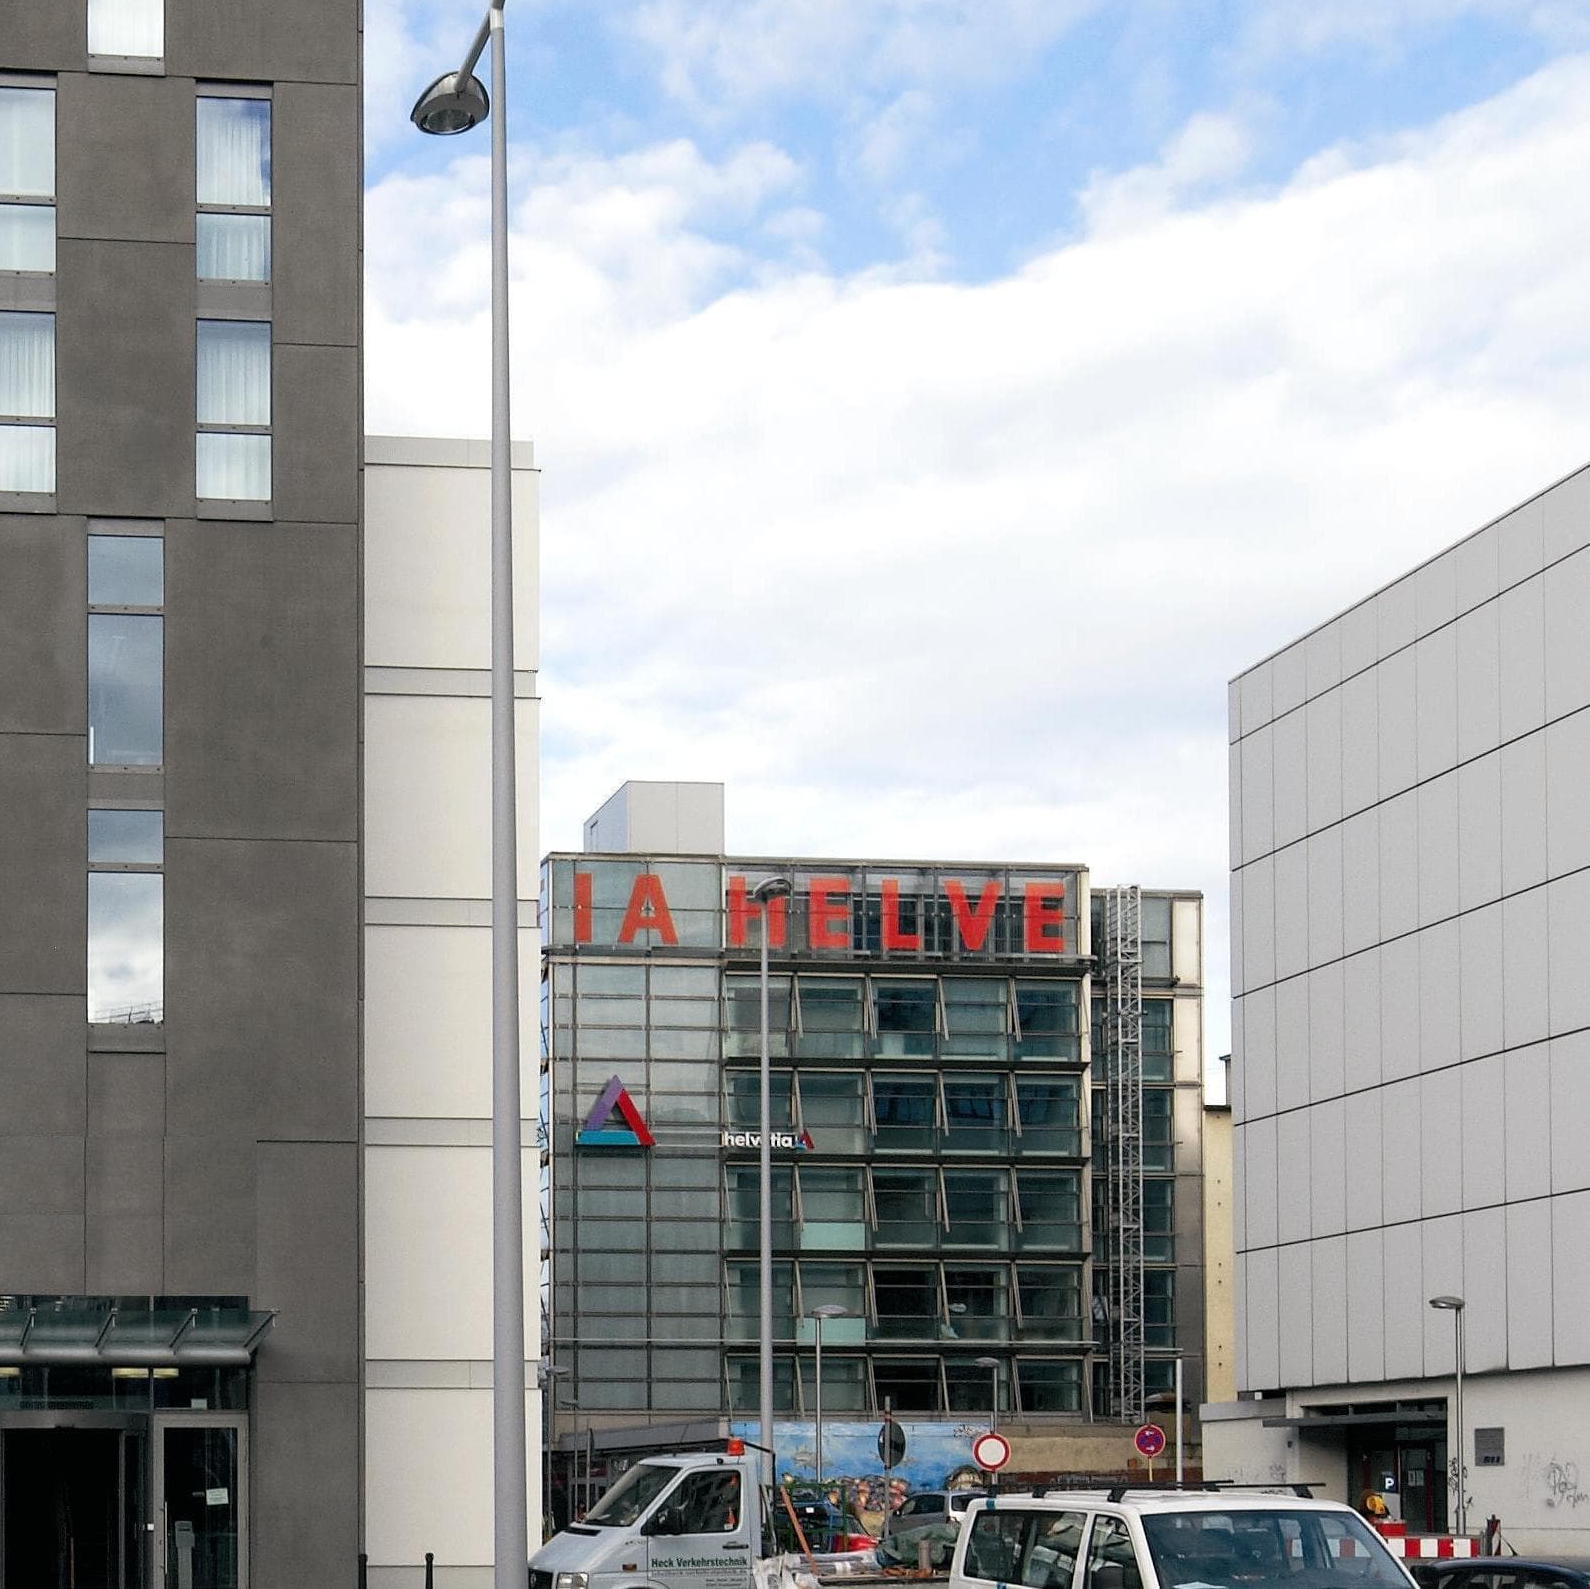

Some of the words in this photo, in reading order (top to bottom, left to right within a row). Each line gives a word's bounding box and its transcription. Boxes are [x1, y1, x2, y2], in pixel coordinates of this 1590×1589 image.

[729, 876, 1066, 952] HELVE
[724, 1132, 793, 1147] helvtia
[1385, 1477, 1395, 1490] P
[651, 1558, 673, 1568] Heck
[676, 1556, 747, 1567] Verkehrstechnik
